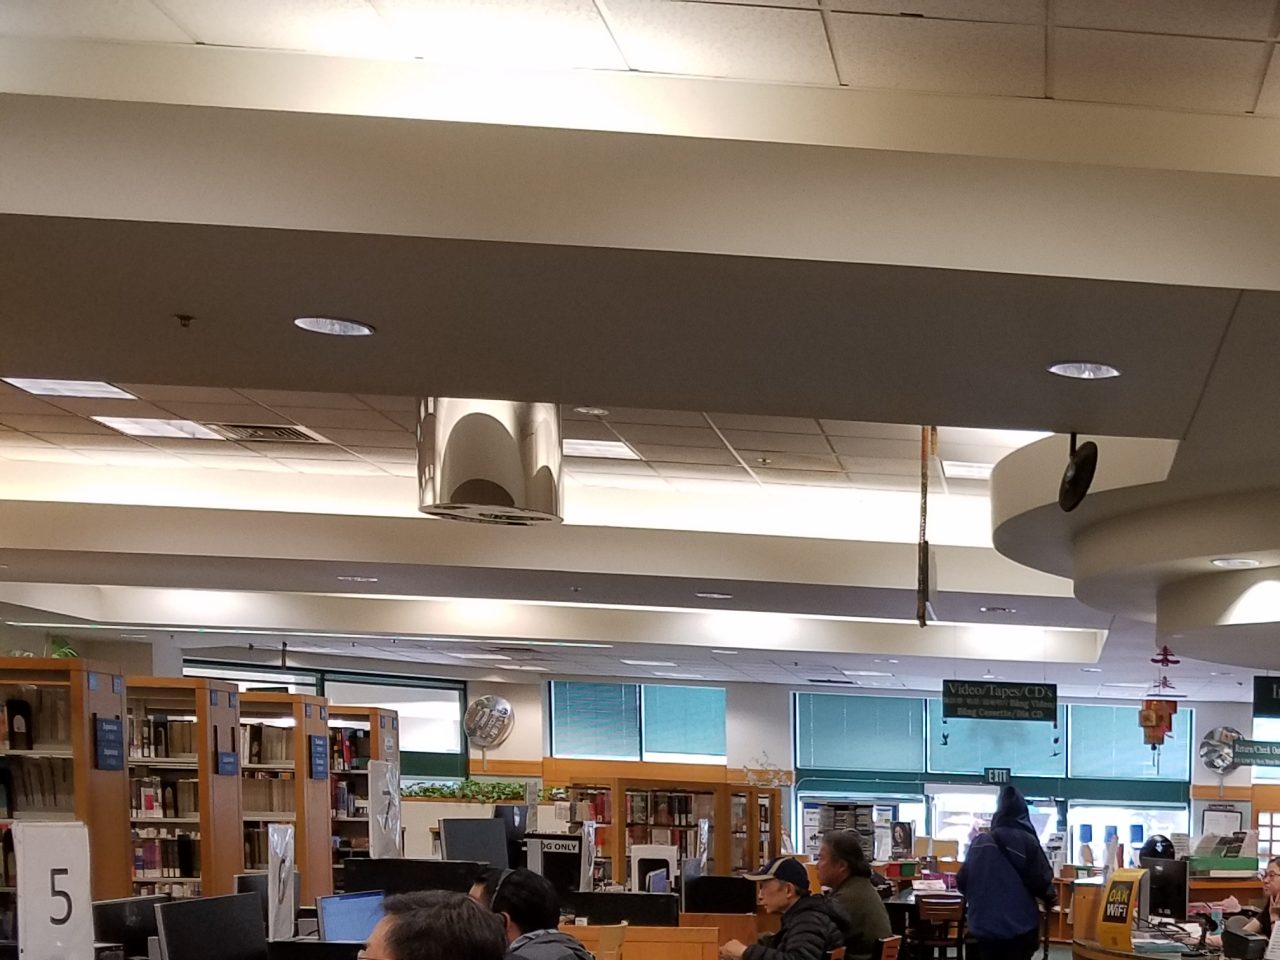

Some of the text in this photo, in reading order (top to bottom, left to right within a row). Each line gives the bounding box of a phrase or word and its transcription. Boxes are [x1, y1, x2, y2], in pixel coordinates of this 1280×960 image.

[948, 682, 1053, 698] Video/Tapes/CD's
[988, 769, 1008, 783] EXIT
[554, 843, 577, 851] ONLY
[49, 868, 73, 926] 5
